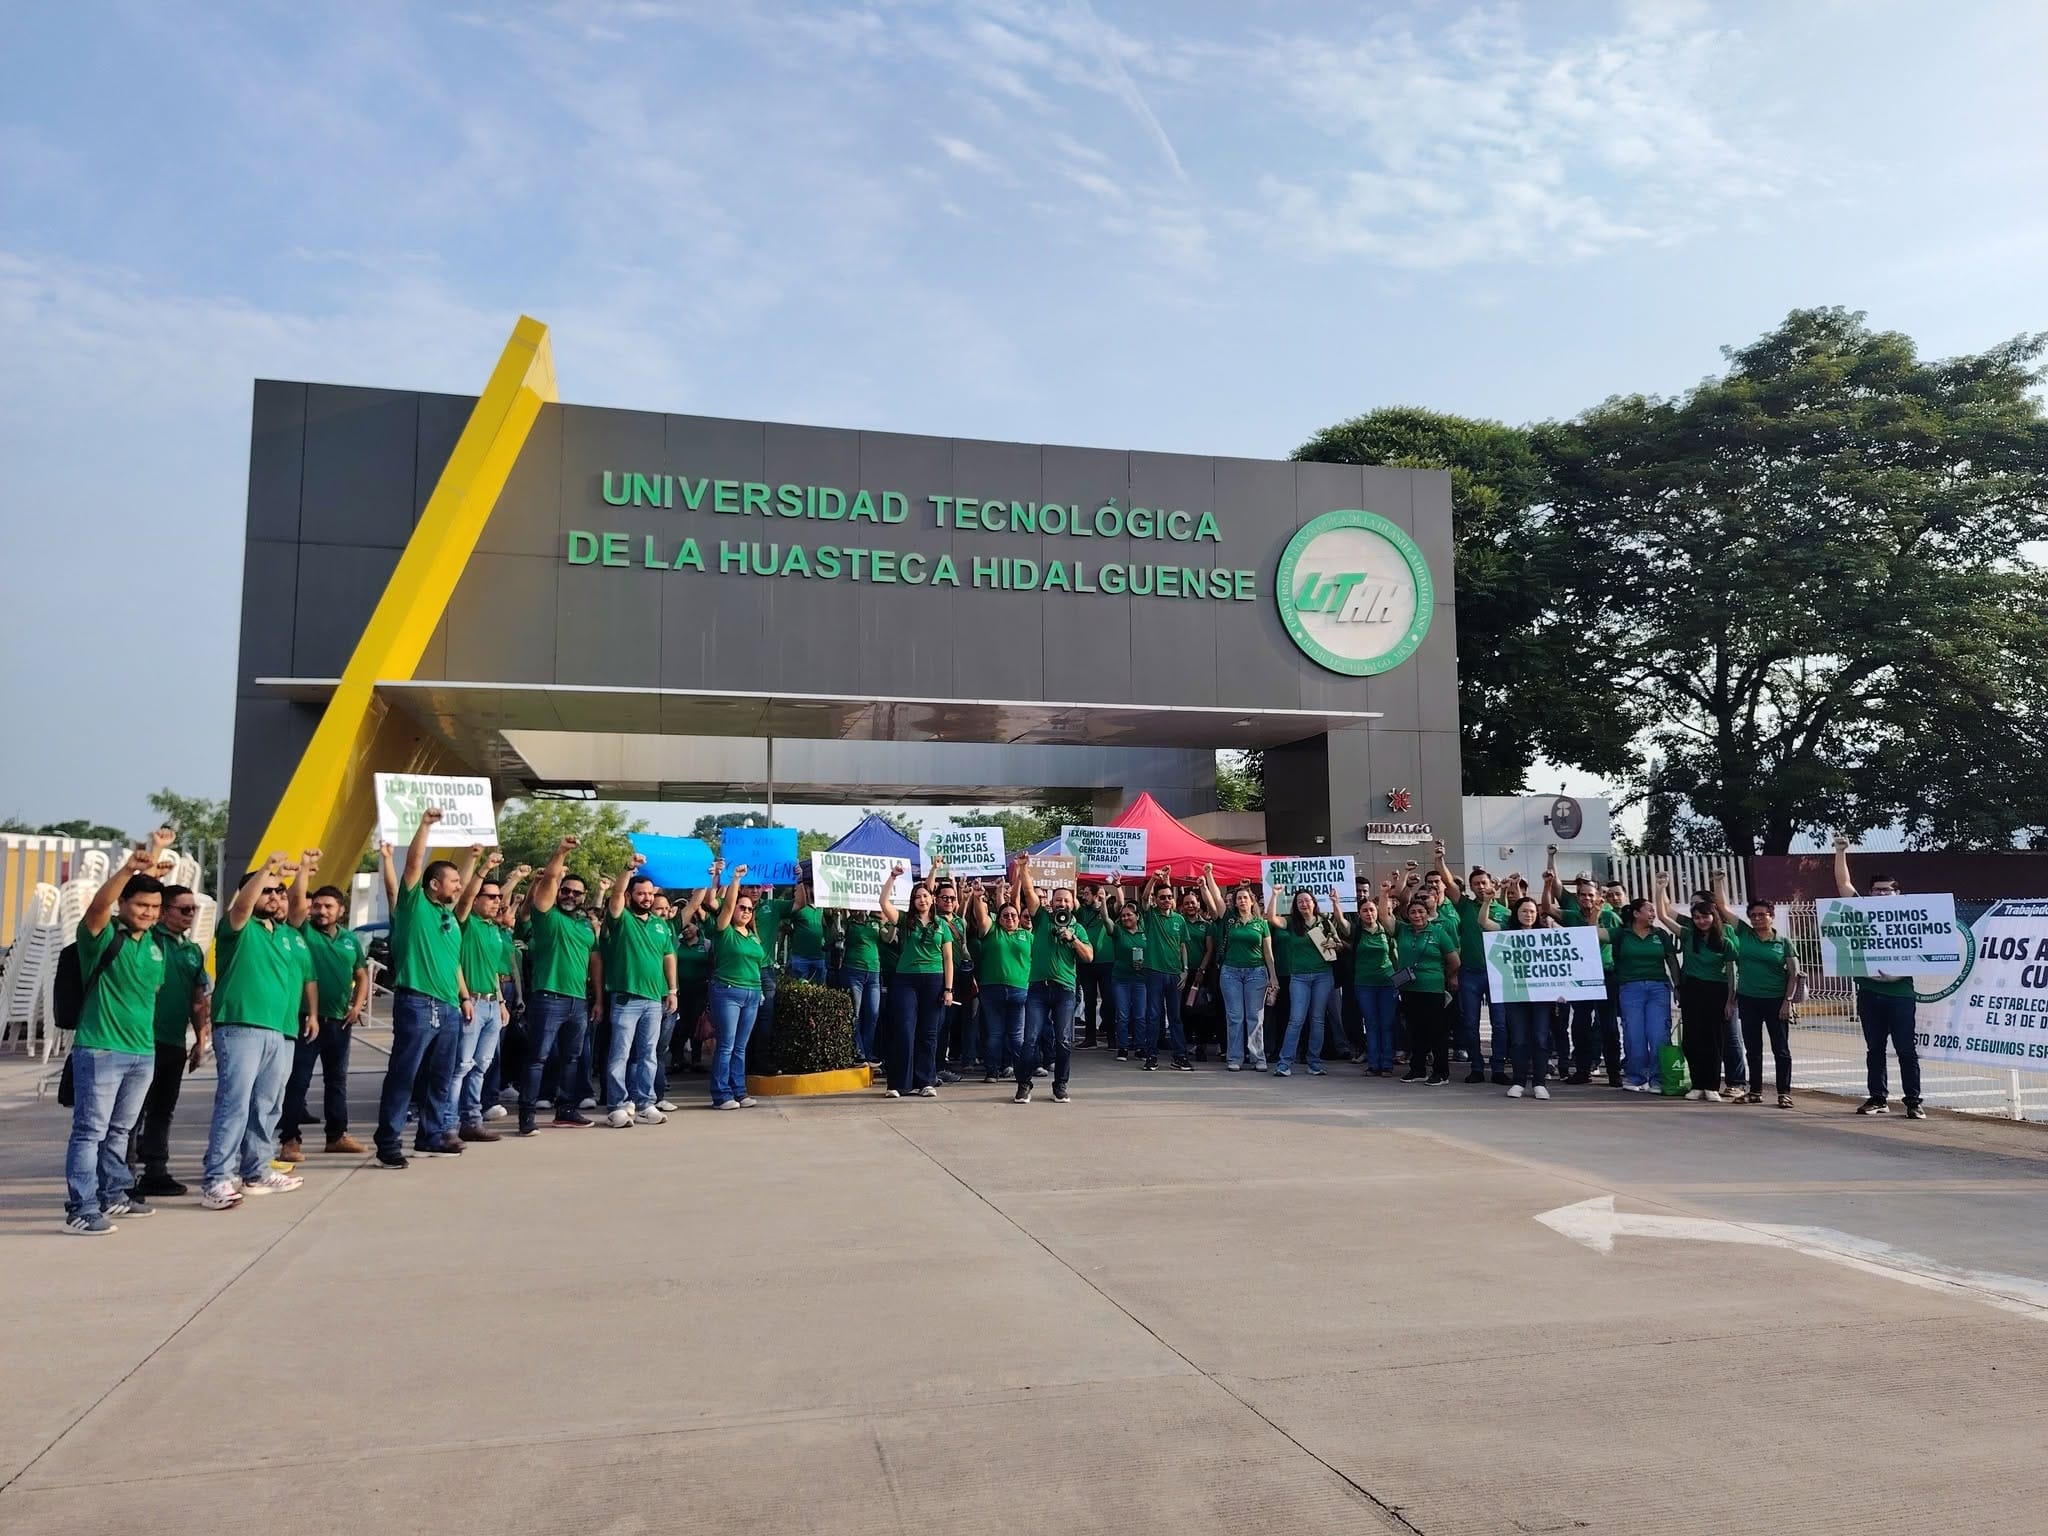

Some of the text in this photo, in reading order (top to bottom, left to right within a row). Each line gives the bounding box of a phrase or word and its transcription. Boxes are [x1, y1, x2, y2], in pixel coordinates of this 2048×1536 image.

[603, 470, 1222, 542] UNIVERSIDAD TECNOLÓGICA
[568, 530, 1257, 601] DE LA HUASTECA HIDALGUENSE
[1295, 572, 1400, 624] UTHH
[385, 779, 484, 796] ¡LA AUTORIDAD
[416, 796, 457, 811] NO HA
[403, 812, 473, 826] CULIDO!
[1068, 830, 1141, 840] ¡EXIGIMOS NUESTRAS
[1369, 823, 1432, 834] HIDALGO
[935, 831, 987, 844] 3 AÑOS DE
[1082, 838, 1127, 847] CONDICIONES
[936, 843, 989, 854] PROMESAS
[1078, 845, 1129, 855] GENERALES DE
[821, 854, 886, 870] ¡QUEREMOS
[930, 853, 996, 865] ICUMPLIDAS
[1028, 857, 1073, 869] Firmar
[1087, 854, 1121, 863] TRABAJO!
[1043, 868, 1057, 876] es
[1270, 859, 1345, 873] SIN FIRMA NO
[846, 869, 882, 882] FIRMA
[1273, 871, 1345, 885] HAY JUSTICIA
[1031, 879, 1073, 889] umplir
[1840, 909, 1928, 923] ¡NO PEDIMOS
[1821, 924, 1882, 938] FAVORES,
[1885, 922, 1952, 936] EXIGIMOS
[1511, 930, 1571, 949] ¡NO MÁS
[1850, 937, 1923, 950] DERECHOS!
[1502, 947, 1583, 964] PROMESAS,
[1978, 936, 2030, 961] ¡LOS
[1513, 963, 1573, 979] HECHOS!
[1969, 994, 1985, 1008] SE
[1986, 1012, 2000, 1025] EL
[2004, 1013, 2017, 1027] 31
[2020, 1014, 2036, 1028] DE
[1933, 1034, 1962, 1052] 2026,
[1966, 1037, 2025, 1056] SEGUIMOS
